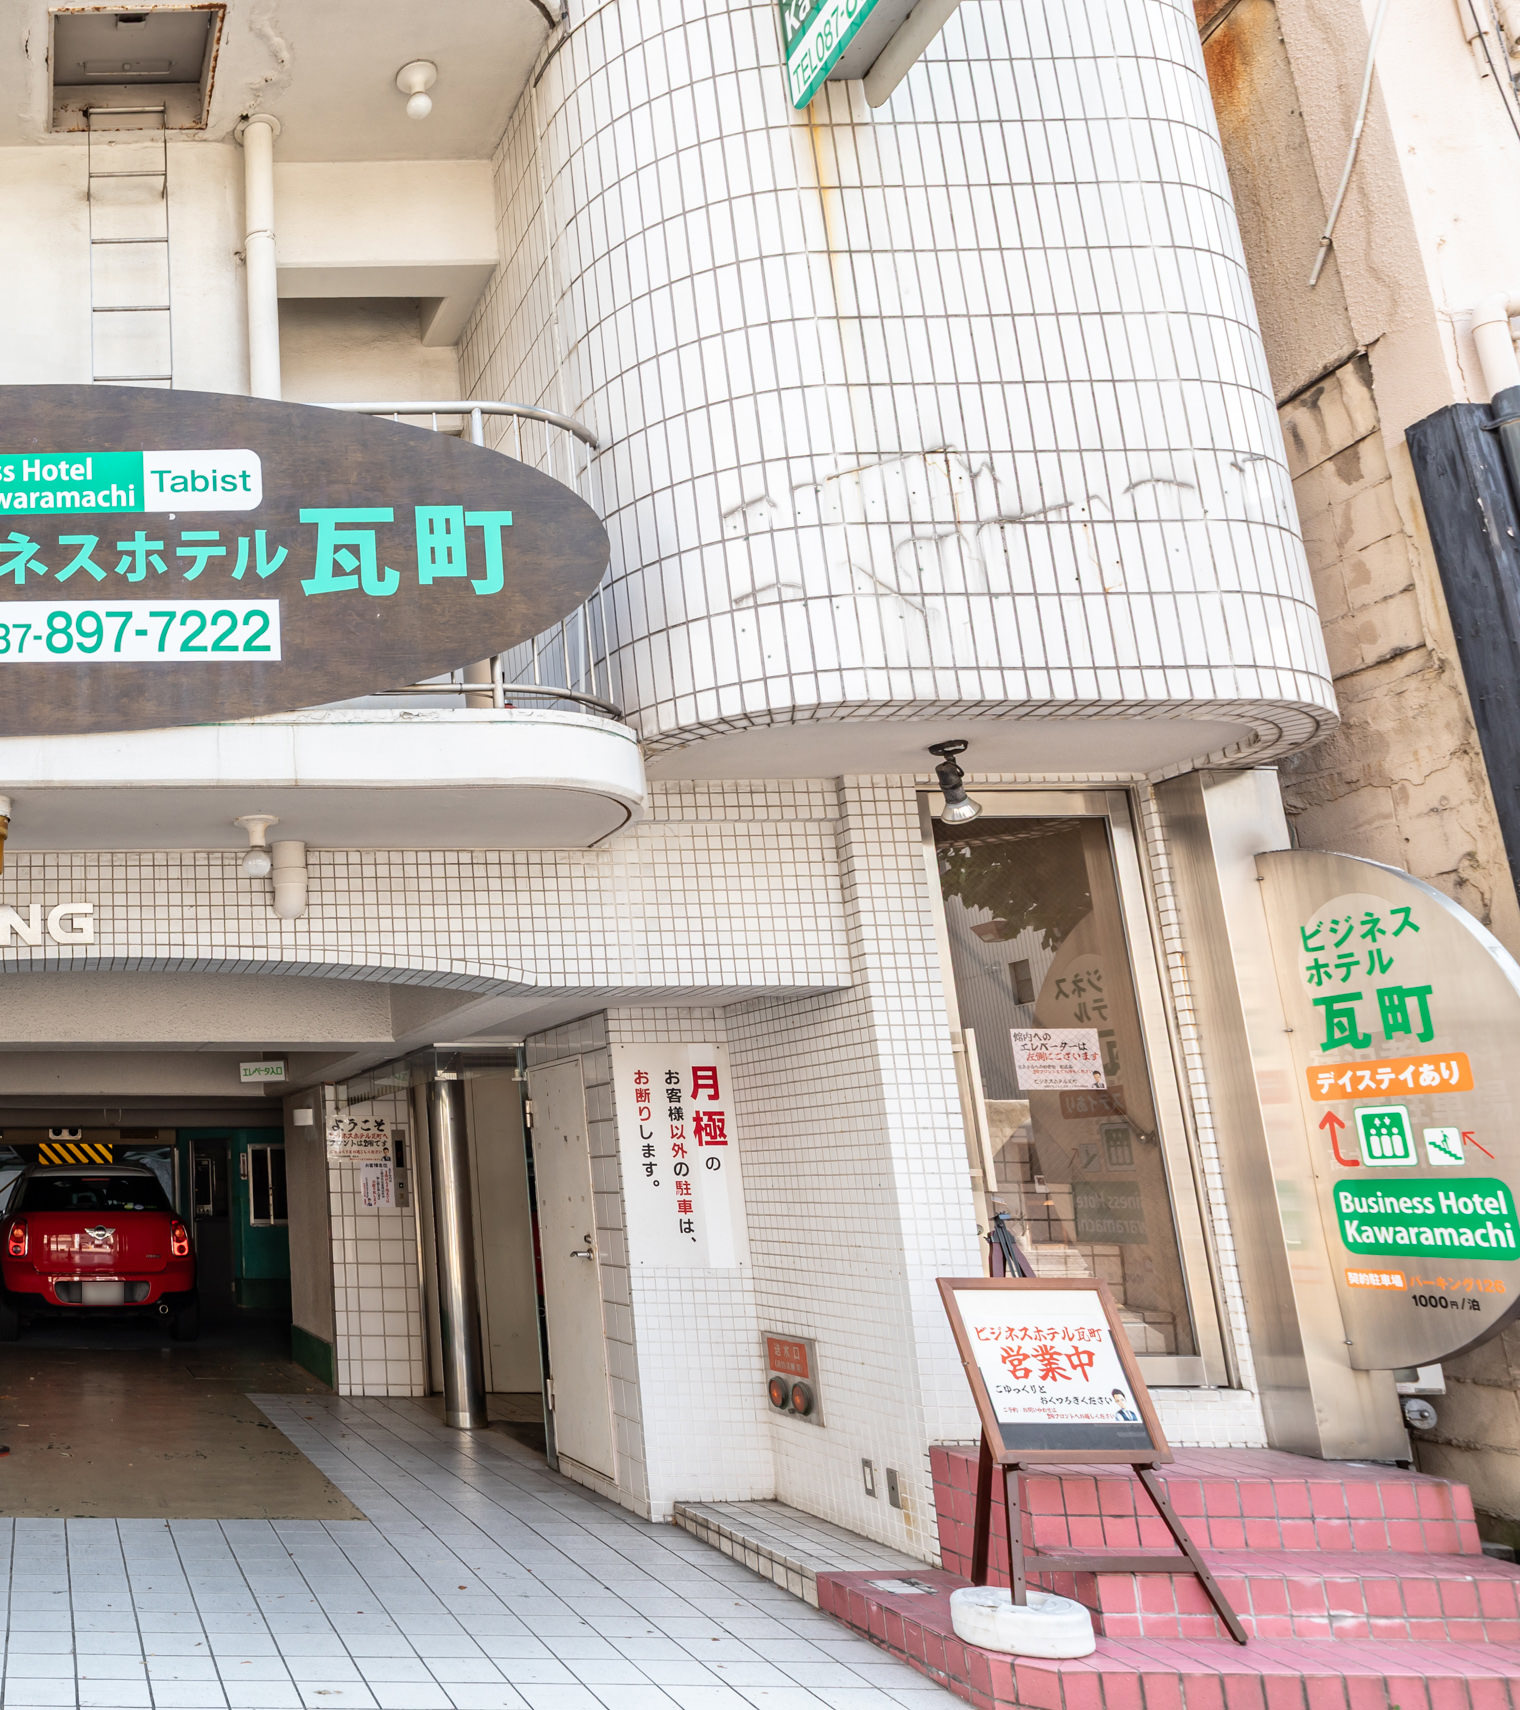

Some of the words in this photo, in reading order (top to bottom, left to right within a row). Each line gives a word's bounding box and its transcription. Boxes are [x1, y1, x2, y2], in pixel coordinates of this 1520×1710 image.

[22, 457, 93, 482] Hotel
[150, 469, 252, 493] Tabist
[1300, 906, 1420, 953] ビジネス
[1305, 947, 1394, 987] ホテル
[1312, 984, 1434, 1053] 瓦町
[1021, 1041, 1088, 1051] エレベーターは
[1316, 1060, 1460, 1094] デイステイあり
[331, 1118, 385, 1132] ようこそ
[633, 1069, 660, 1187] お断りします。
[1338, 1191, 1435, 1215] Business
[1438, 1190, 1509, 1215] Hotel
[1344, 1220, 1516, 1248] Kawaramachi
[1347, 1272, 1404, 1287] 契約駐車場
[974, 1326, 1103, 1343] ビジネスホテル瓦町
[1000, 1344, 1096, 1382] 営業中
